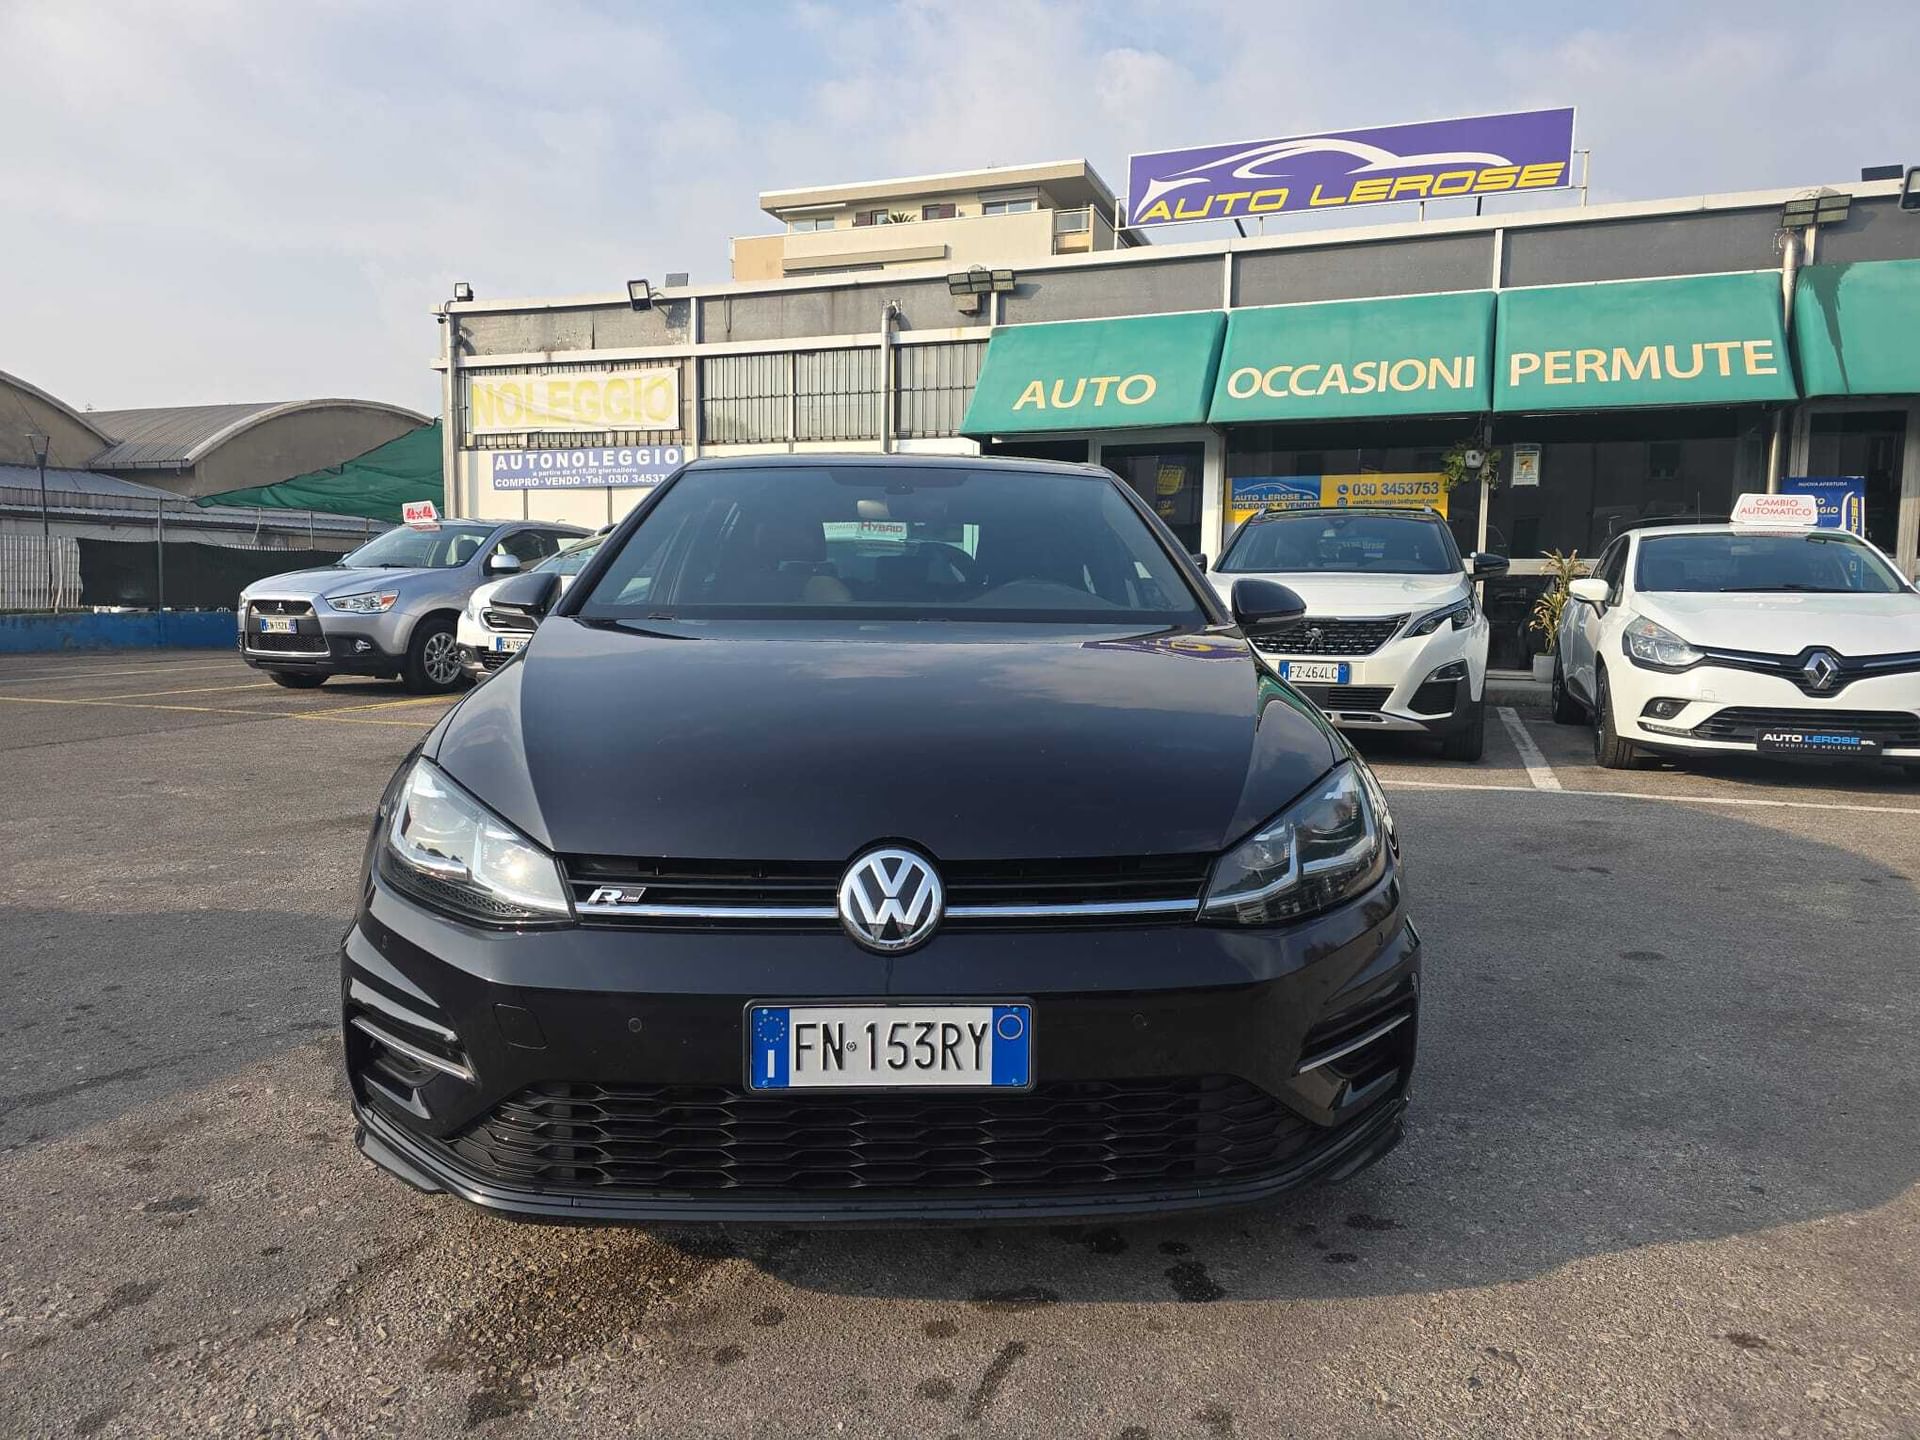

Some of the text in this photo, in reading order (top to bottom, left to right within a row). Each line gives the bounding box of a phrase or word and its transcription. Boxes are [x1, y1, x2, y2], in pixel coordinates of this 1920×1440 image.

[1138, 161, 1566, 223] AUTO LEROSE
[1509, 339, 1778, 387] PERMUTE
[1226, 355, 1477, 399] OCCASIONI
[1012, 373, 1157, 411] AUTO
[472, 376, 674, 427] NOLEGGIO
[495, 448, 680, 470] AUTONOLEGGIO
[495, 478, 539, 487] COMPRO
[545, 476, 580, 486] VENDO
[608, 474, 629, 483] 030
[631, 473, 669, 483] 34537
[1352, 481, 1439, 496] 030 3453753
[1740, 506, 1812, 517] AUTOMATICO
[1755, 498, 1798, 507] CAMBIO
[406, 505, 433, 520] 4x4
[1289, 665, 1338, 679] FZ 464LC
[1762, 733, 1803, 743] AUTO
[1804, 735, 1860, 745] LEROSE
[794, 1021, 989, 1071] FN 153RY
